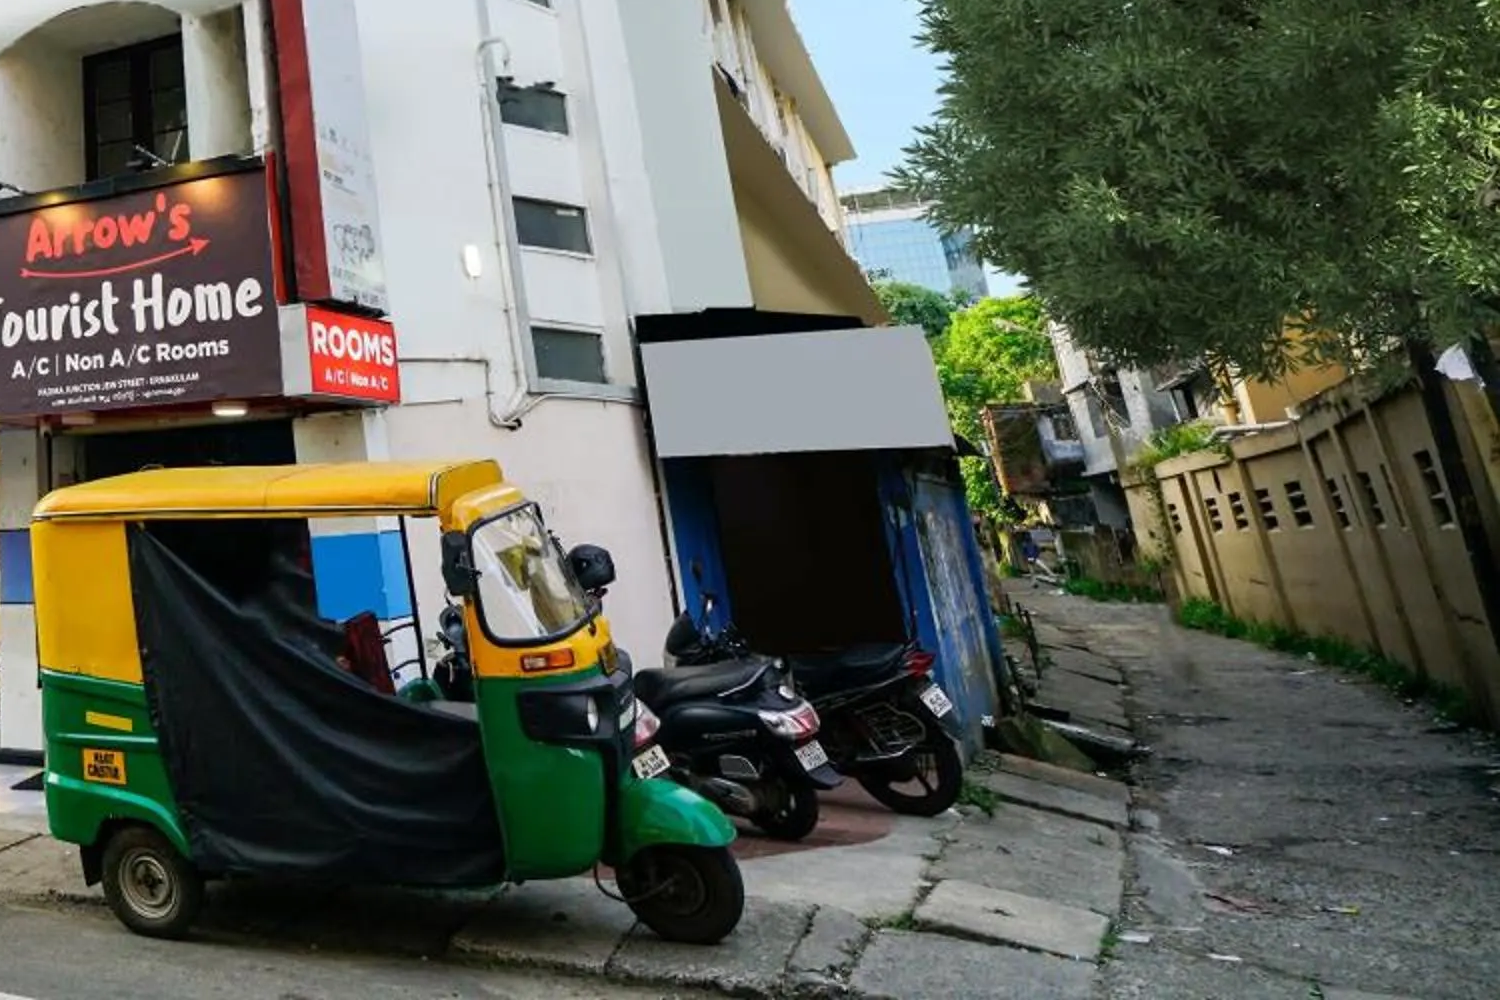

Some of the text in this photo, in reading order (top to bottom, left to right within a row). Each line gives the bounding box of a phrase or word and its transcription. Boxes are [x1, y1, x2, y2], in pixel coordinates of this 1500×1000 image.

[25, 192, 192, 264] Arrow's
[131, 272, 263, 333] Home
[11, 339, 230, 380] A/C Non A/C Rooms
[310, 321, 396, 368] ROOMS
[324, 366, 346, 386] A/C
